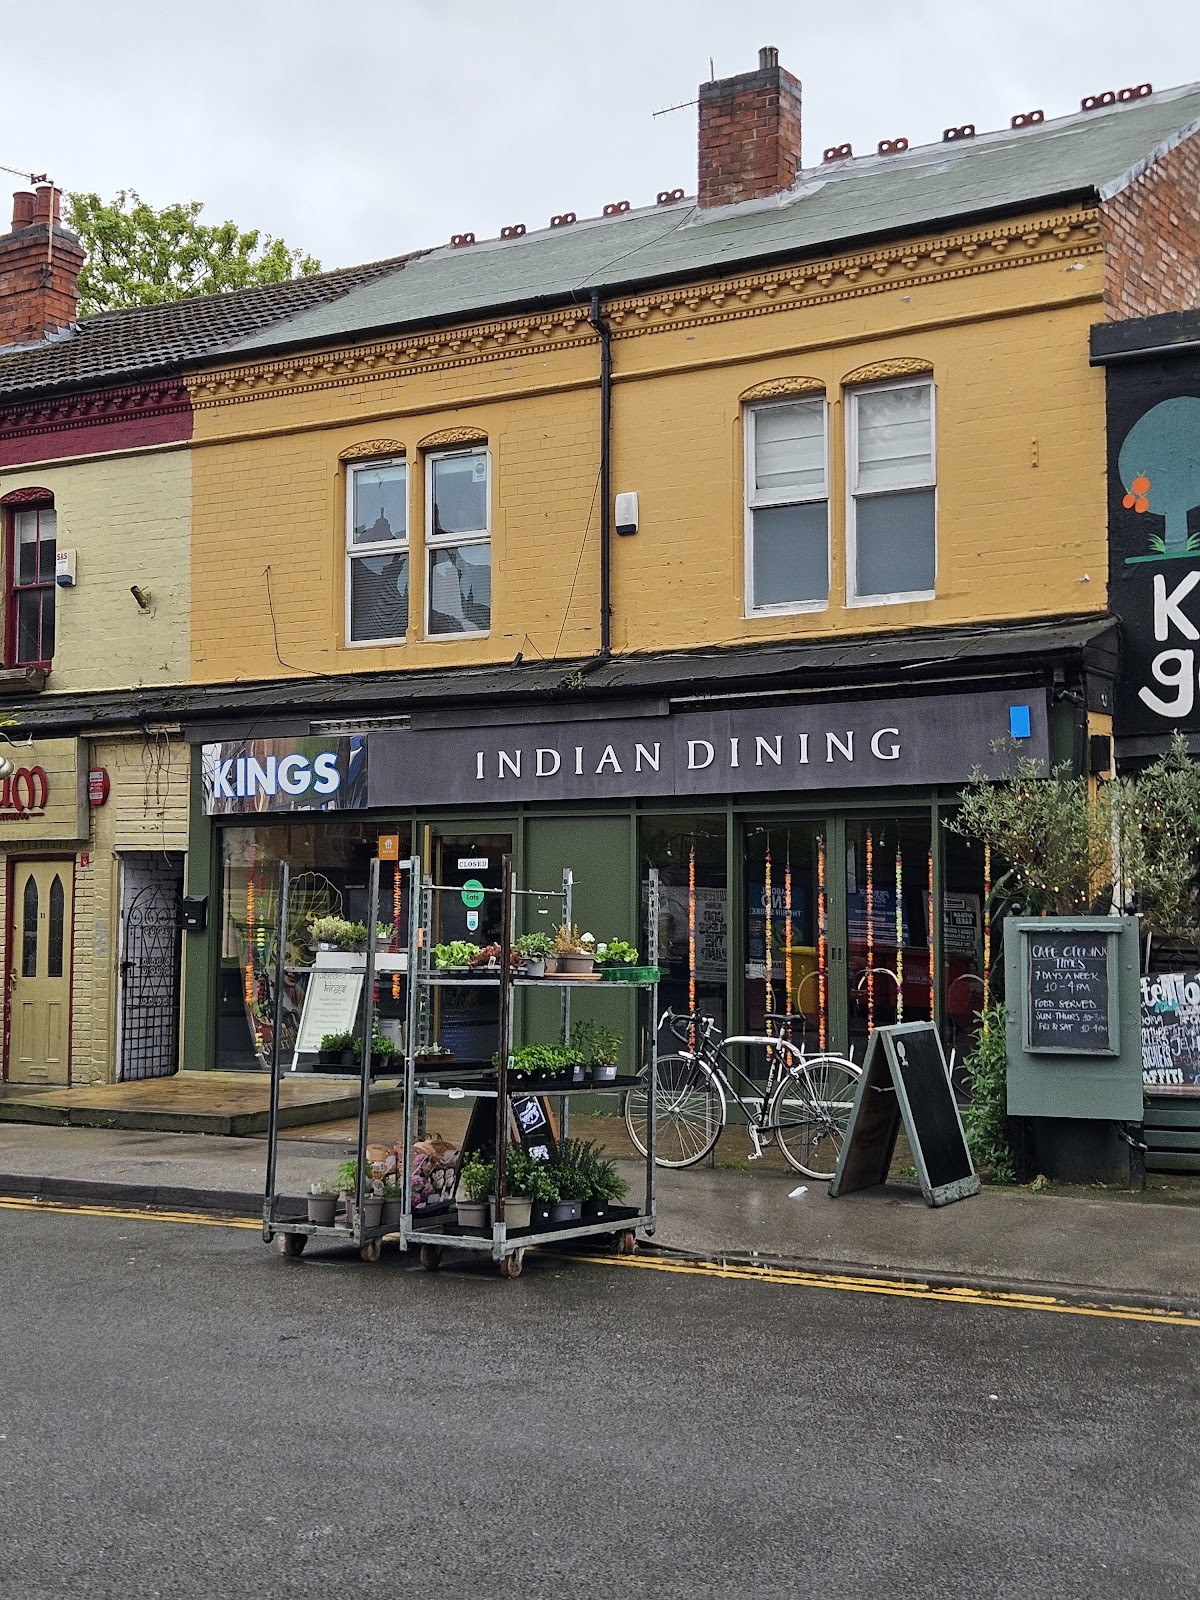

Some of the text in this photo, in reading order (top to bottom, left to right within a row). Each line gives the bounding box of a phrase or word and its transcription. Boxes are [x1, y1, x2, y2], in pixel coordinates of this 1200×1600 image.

[476, 727, 901, 779] INDIAN DINING
[213, 752, 340, 799] KINGS
[1054, 958, 1085, 969] TIMES
[1074, 972, 1100, 981] WEEK
[1034, 998, 1097, 1009] FOOD SERVED
[1060, 1023, 1074, 1032] SAT
